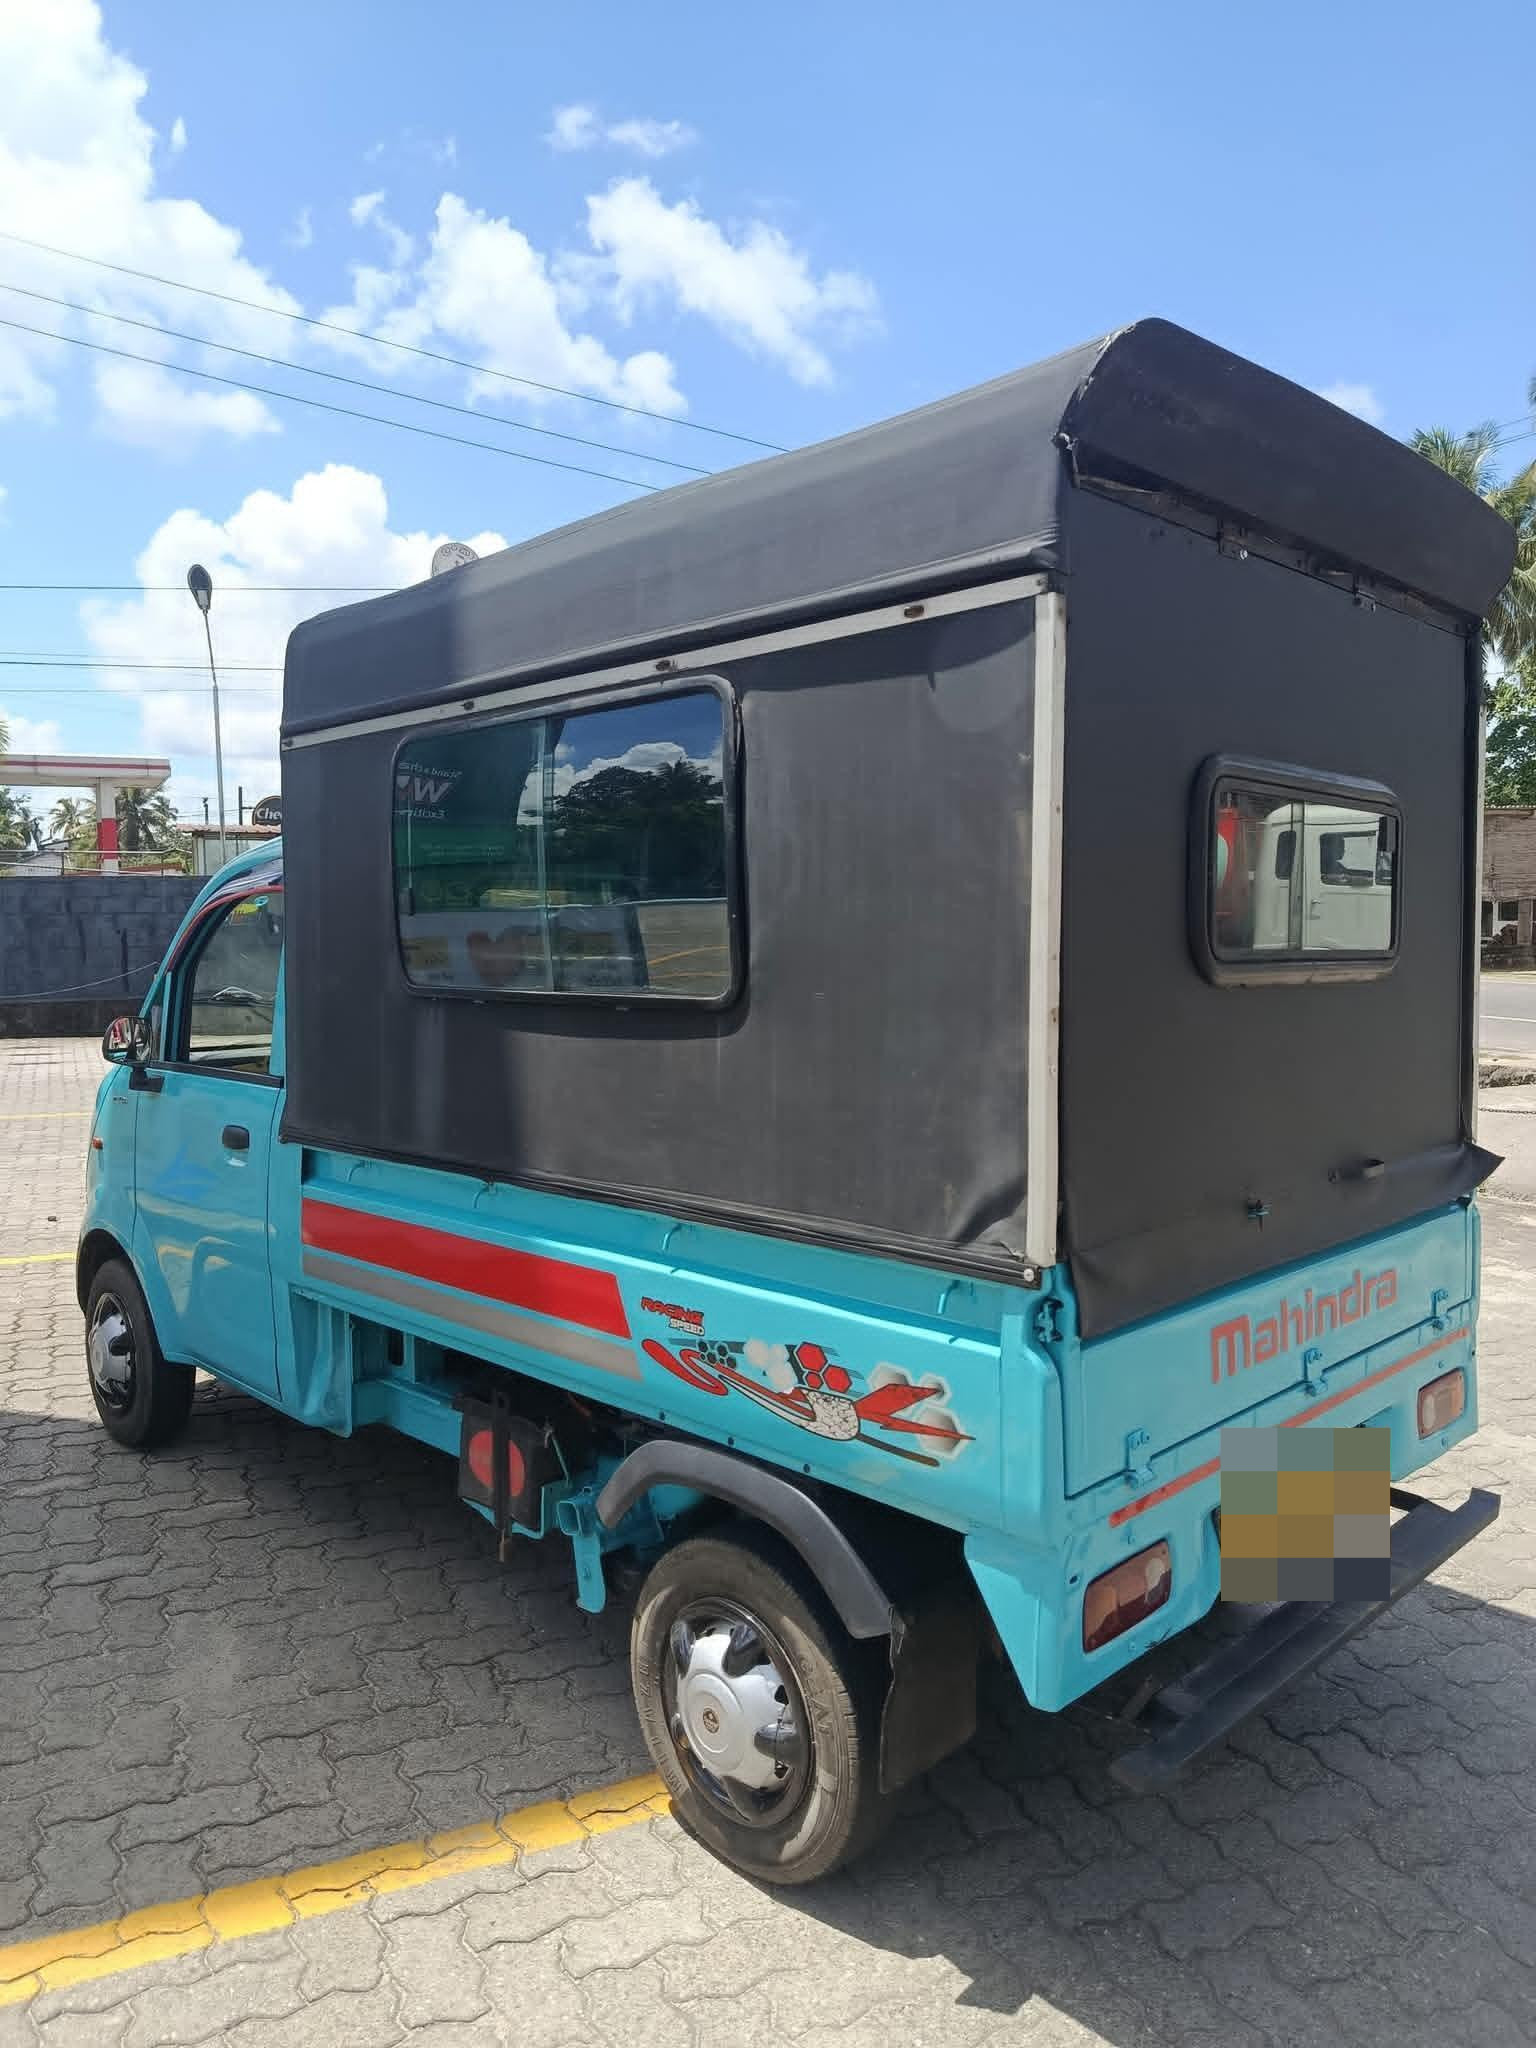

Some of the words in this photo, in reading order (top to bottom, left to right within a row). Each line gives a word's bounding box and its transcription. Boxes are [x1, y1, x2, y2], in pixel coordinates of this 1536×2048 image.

[256, 807, 282, 820] Che
[669, 1317, 705, 1336] SPEED
[1210, 1268, 1397, 1384] Mahindra
